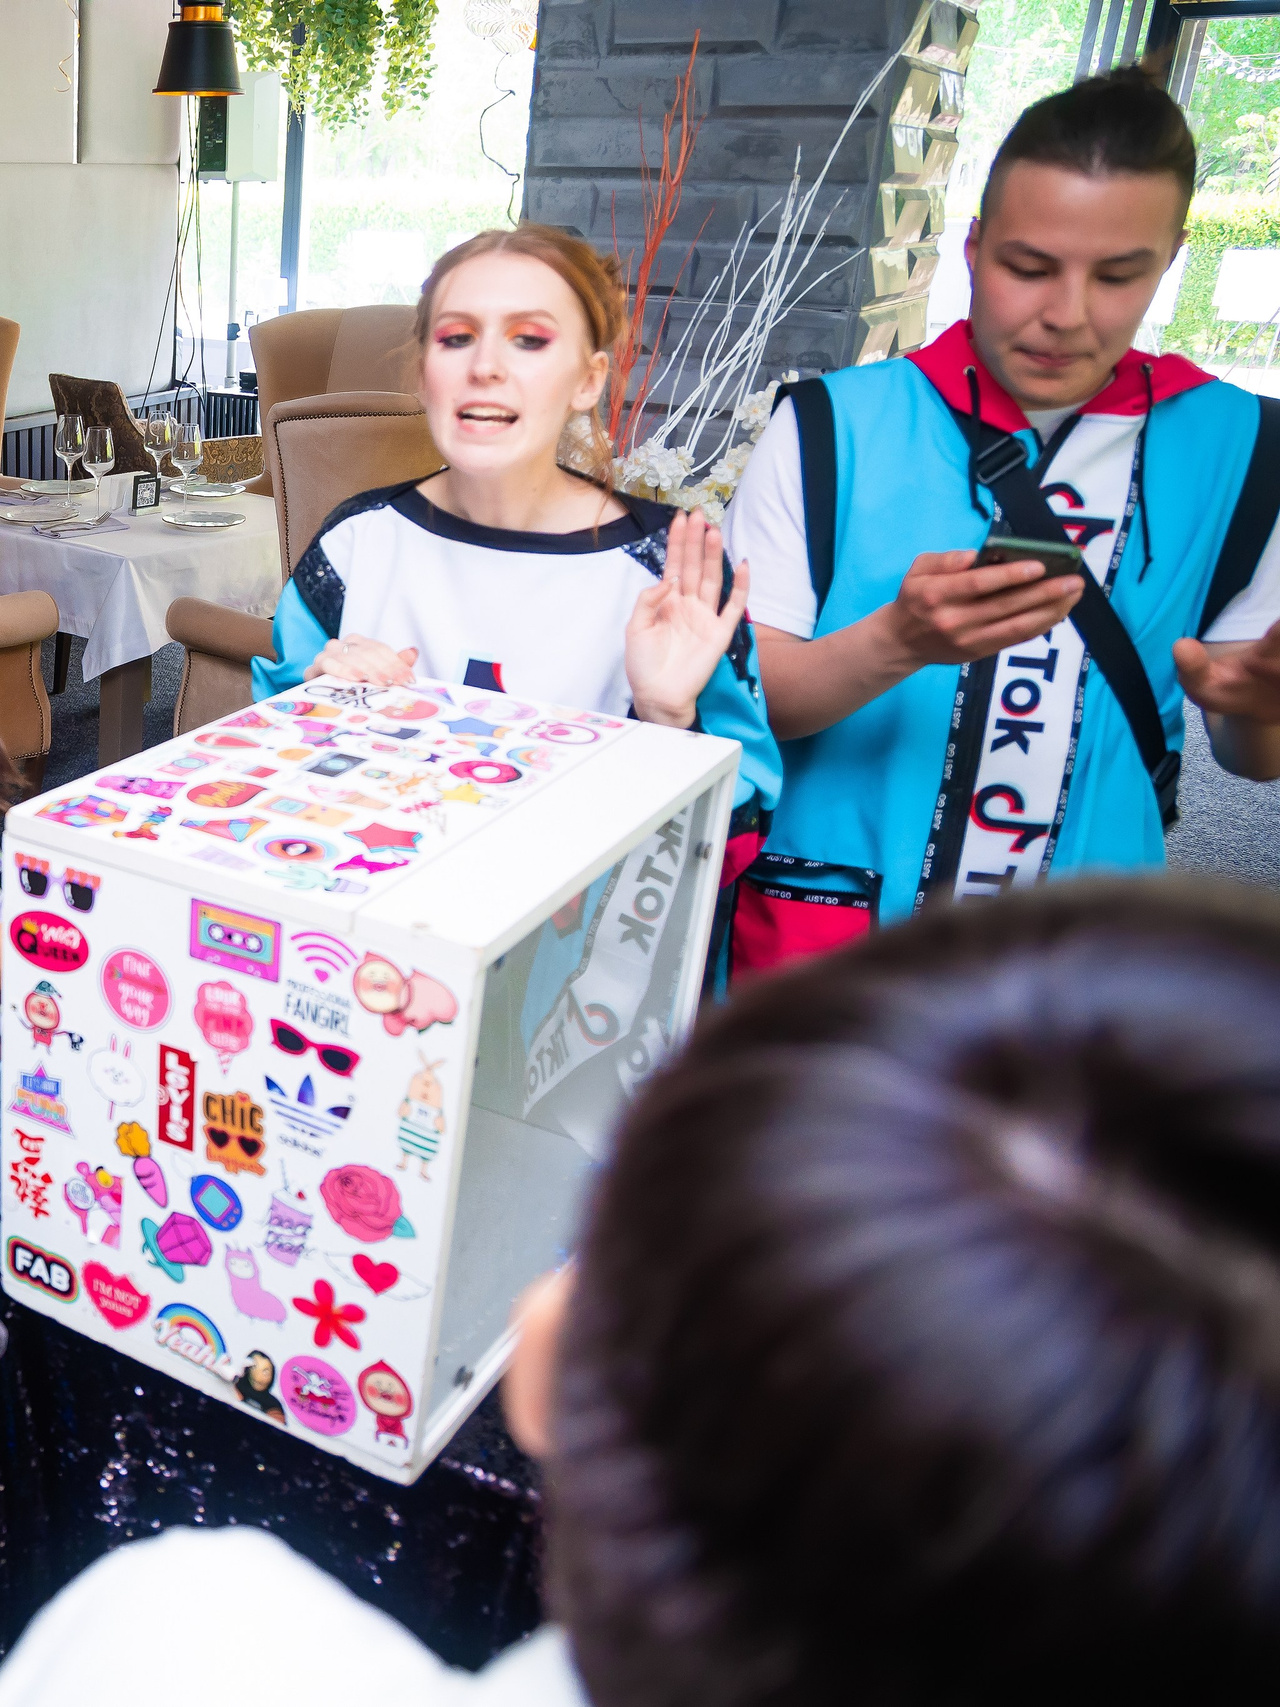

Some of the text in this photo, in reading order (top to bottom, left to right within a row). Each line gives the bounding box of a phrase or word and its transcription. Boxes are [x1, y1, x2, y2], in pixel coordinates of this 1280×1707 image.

[951, 691, 964, 730] JUST GO
[943, 742, 956, 781] JUST GO
[933, 793, 947, 831] JUST GO
[766, 854, 795, 865] JUST GO
[922, 843, 935, 880] JUST GO
[803, 894, 839, 905] JUST GO
[852, 900, 869, 909] JUS
[284, 993, 352, 1037] FANGIRL
[15, 1246, 70, 1292] FAB
